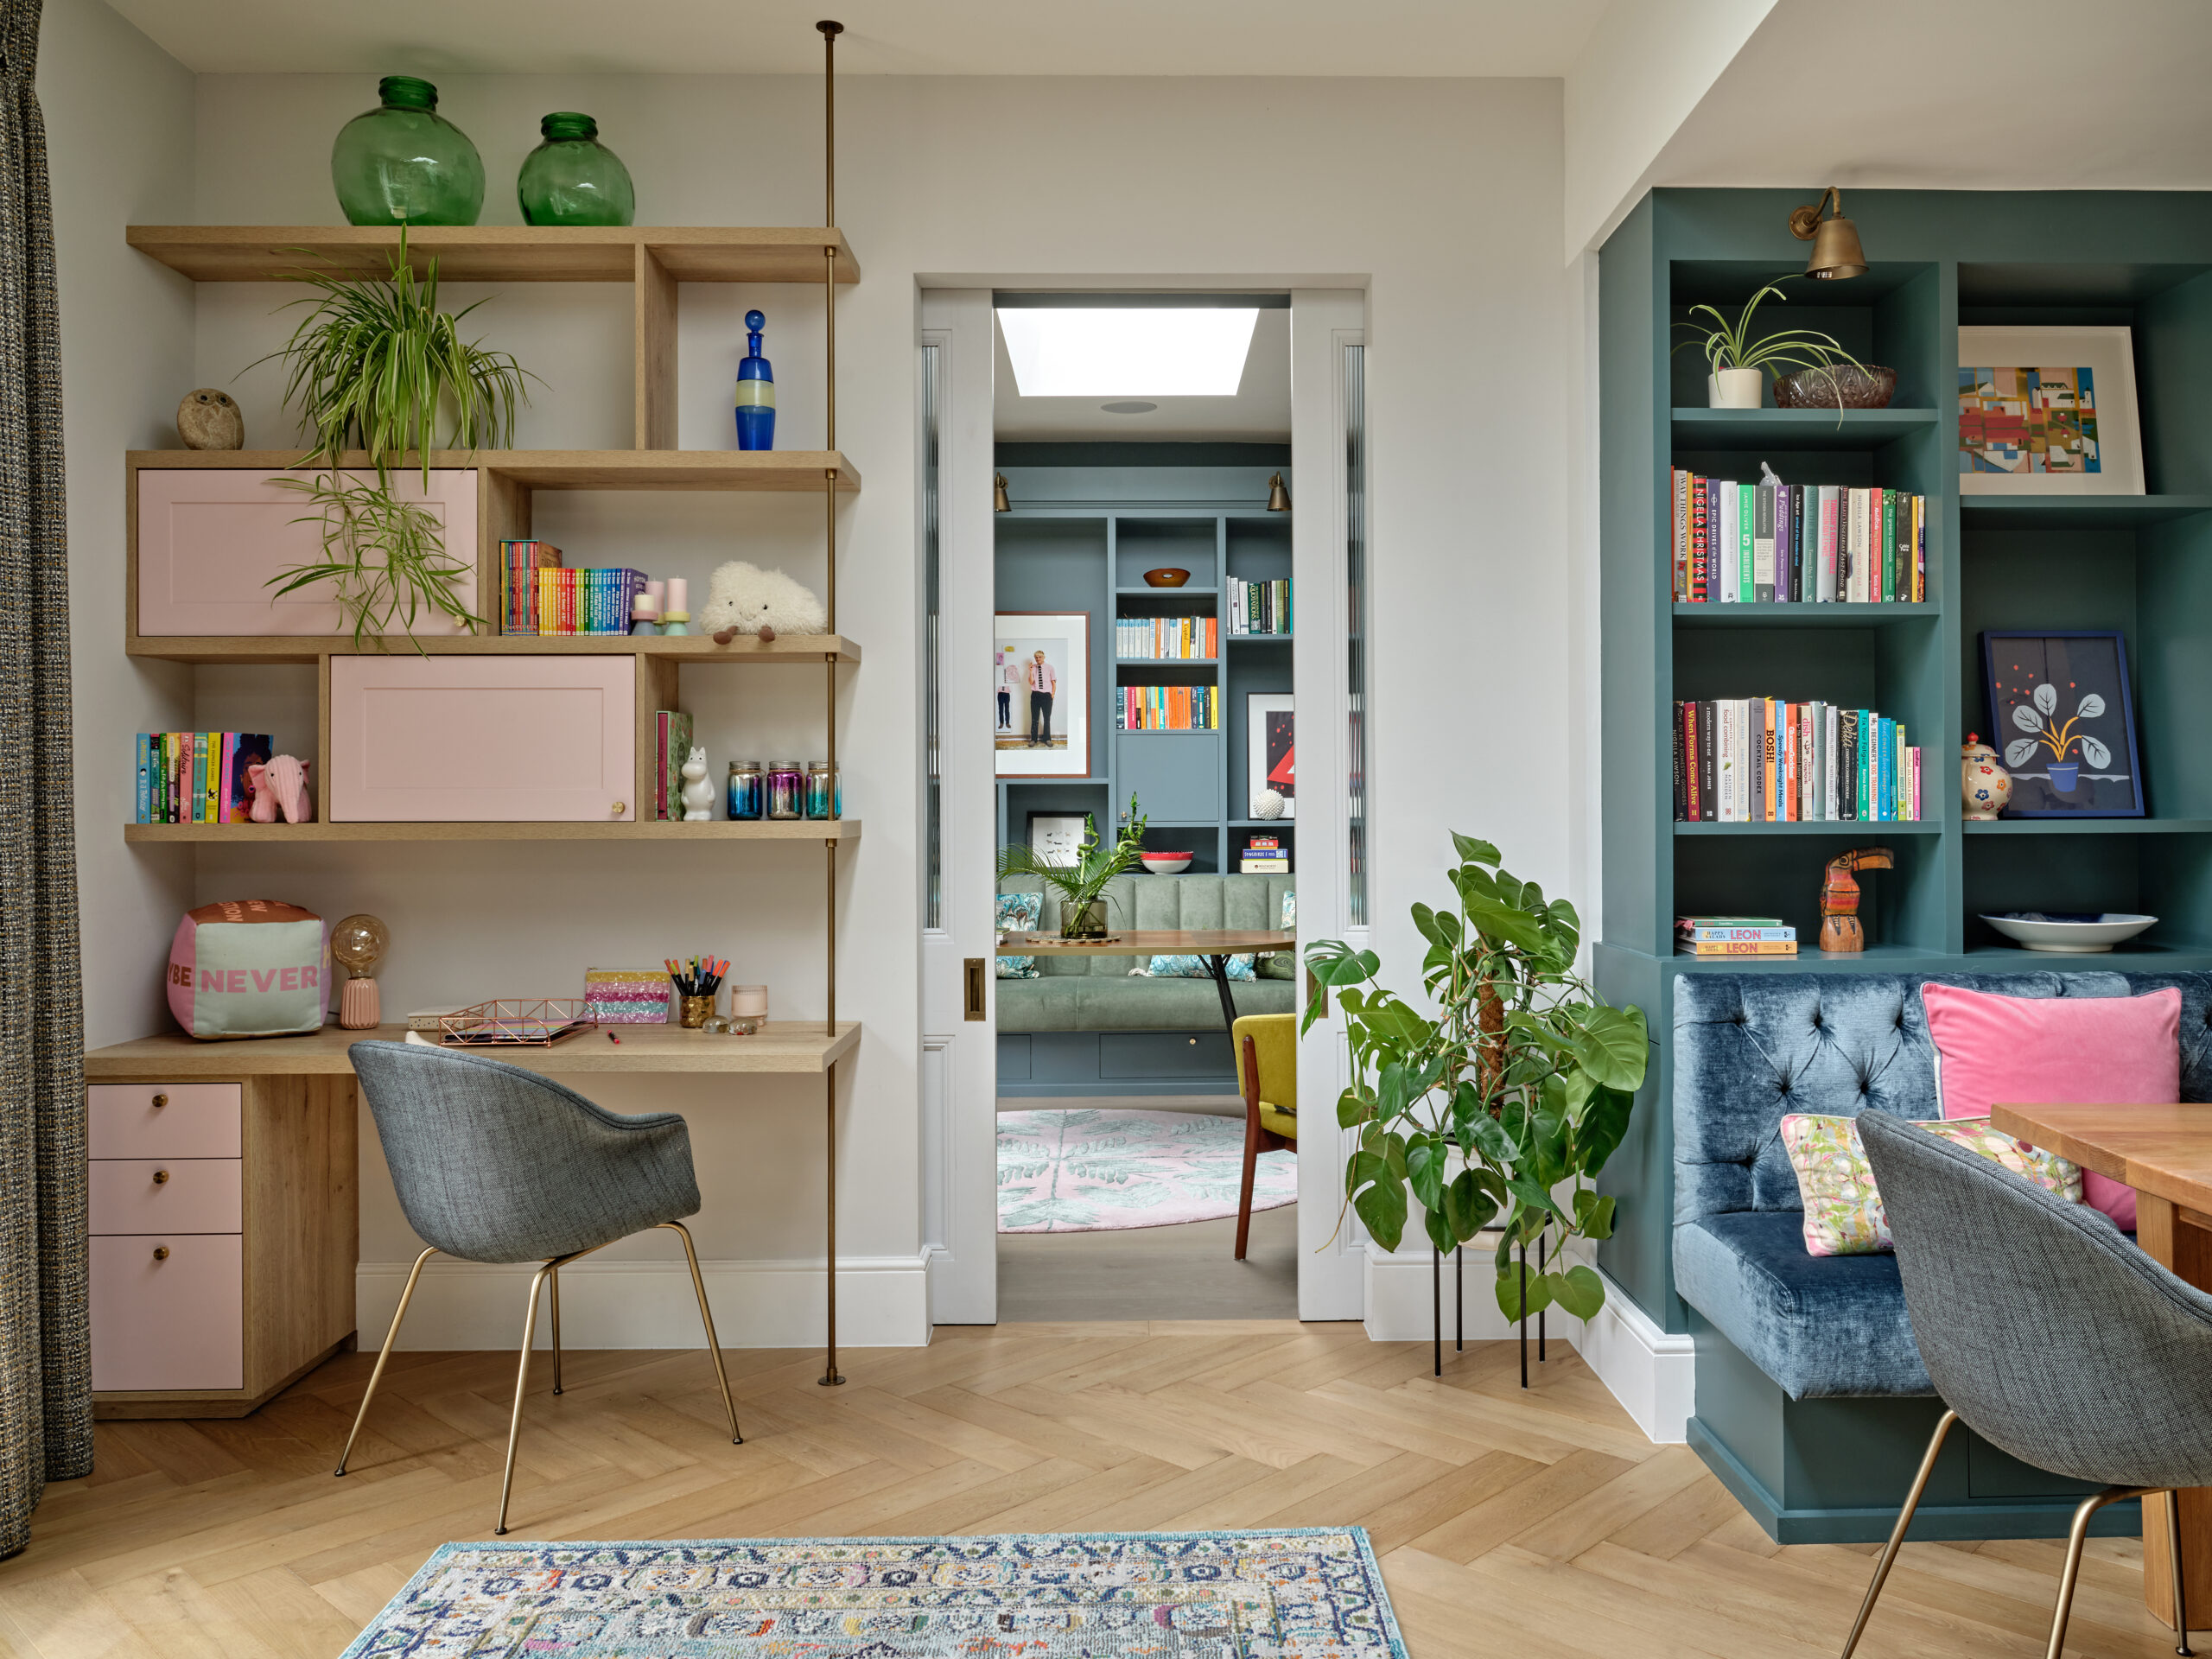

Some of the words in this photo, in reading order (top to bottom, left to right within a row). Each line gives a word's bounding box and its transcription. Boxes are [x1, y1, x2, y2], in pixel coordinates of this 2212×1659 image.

[1743, 534, 1750, 546] 5
[1696, 530, 1705, 582] CHRISTMAS
[1842, 715, 1858, 747] Delia
[181, 744, 190, 774] Solitaire
[1726, 944, 1758, 953] LEON
[1730, 930, 1761, 939] LEON
[201, 965, 318, 993] NEVER
